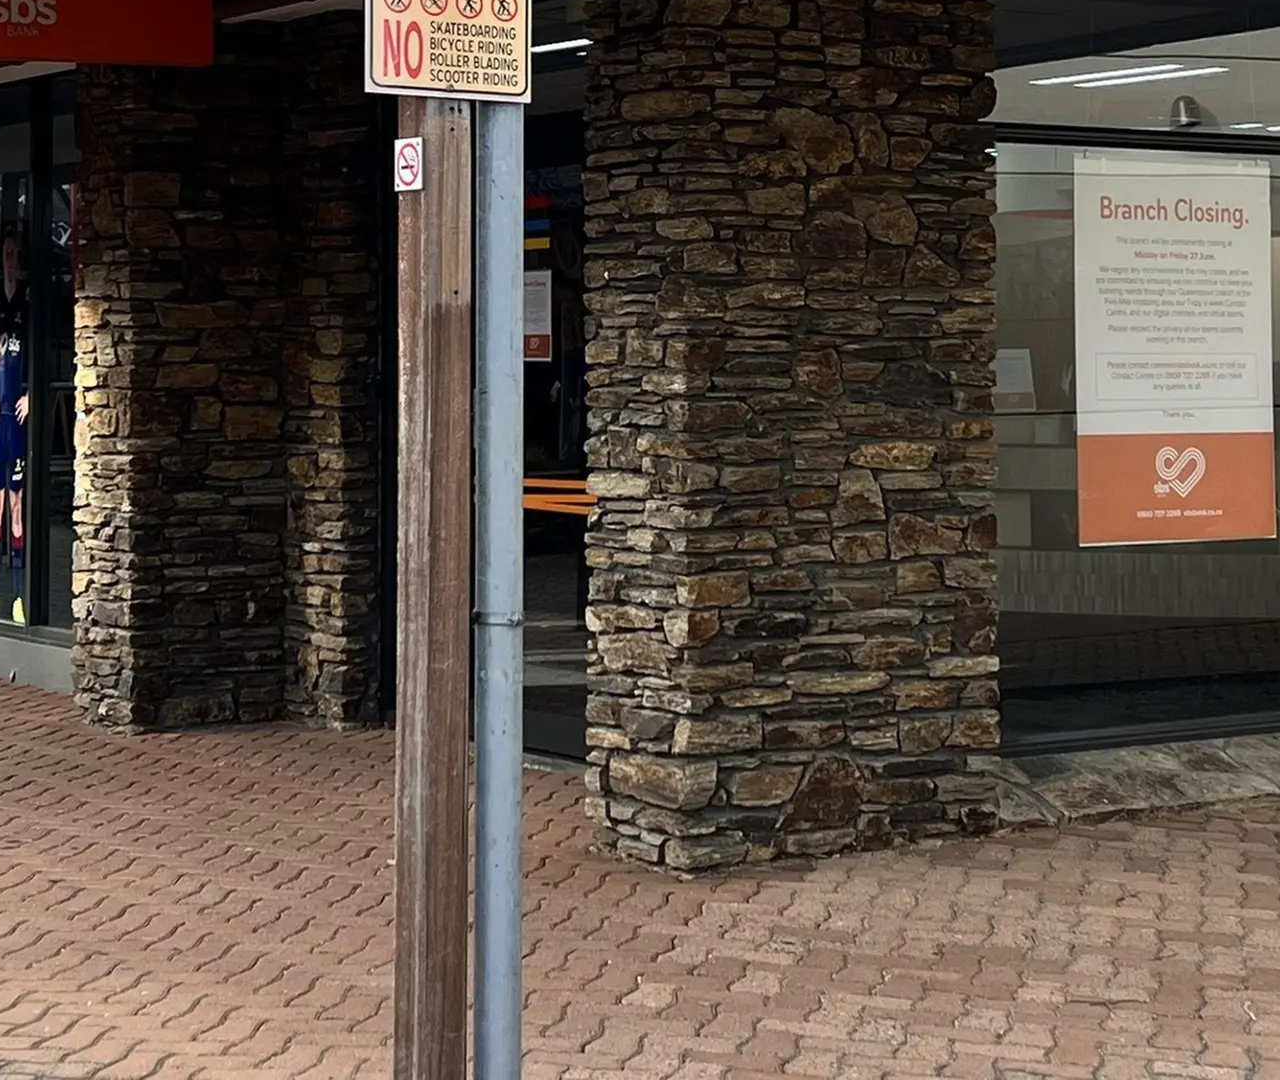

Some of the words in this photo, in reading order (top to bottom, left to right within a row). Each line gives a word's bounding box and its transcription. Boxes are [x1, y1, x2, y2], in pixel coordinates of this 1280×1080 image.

[430, 20, 517, 40] SKATEBOARDING
[383, 19, 424, 80] NO
[430, 37, 474, 54] BICYCLE
[478, 40, 514, 56] RIDING
[430, 53, 470, 68] ROLLER
[473, 56, 519, 72] BLADING
[430, 69, 480, 85] SCOOTER
[482, 72, 518, 87] RIDING
[1100, 195, 1168, 221] Branch
[1174, 198, 1249, 230] Closing.
[1153, 480, 1170, 494] sbs
